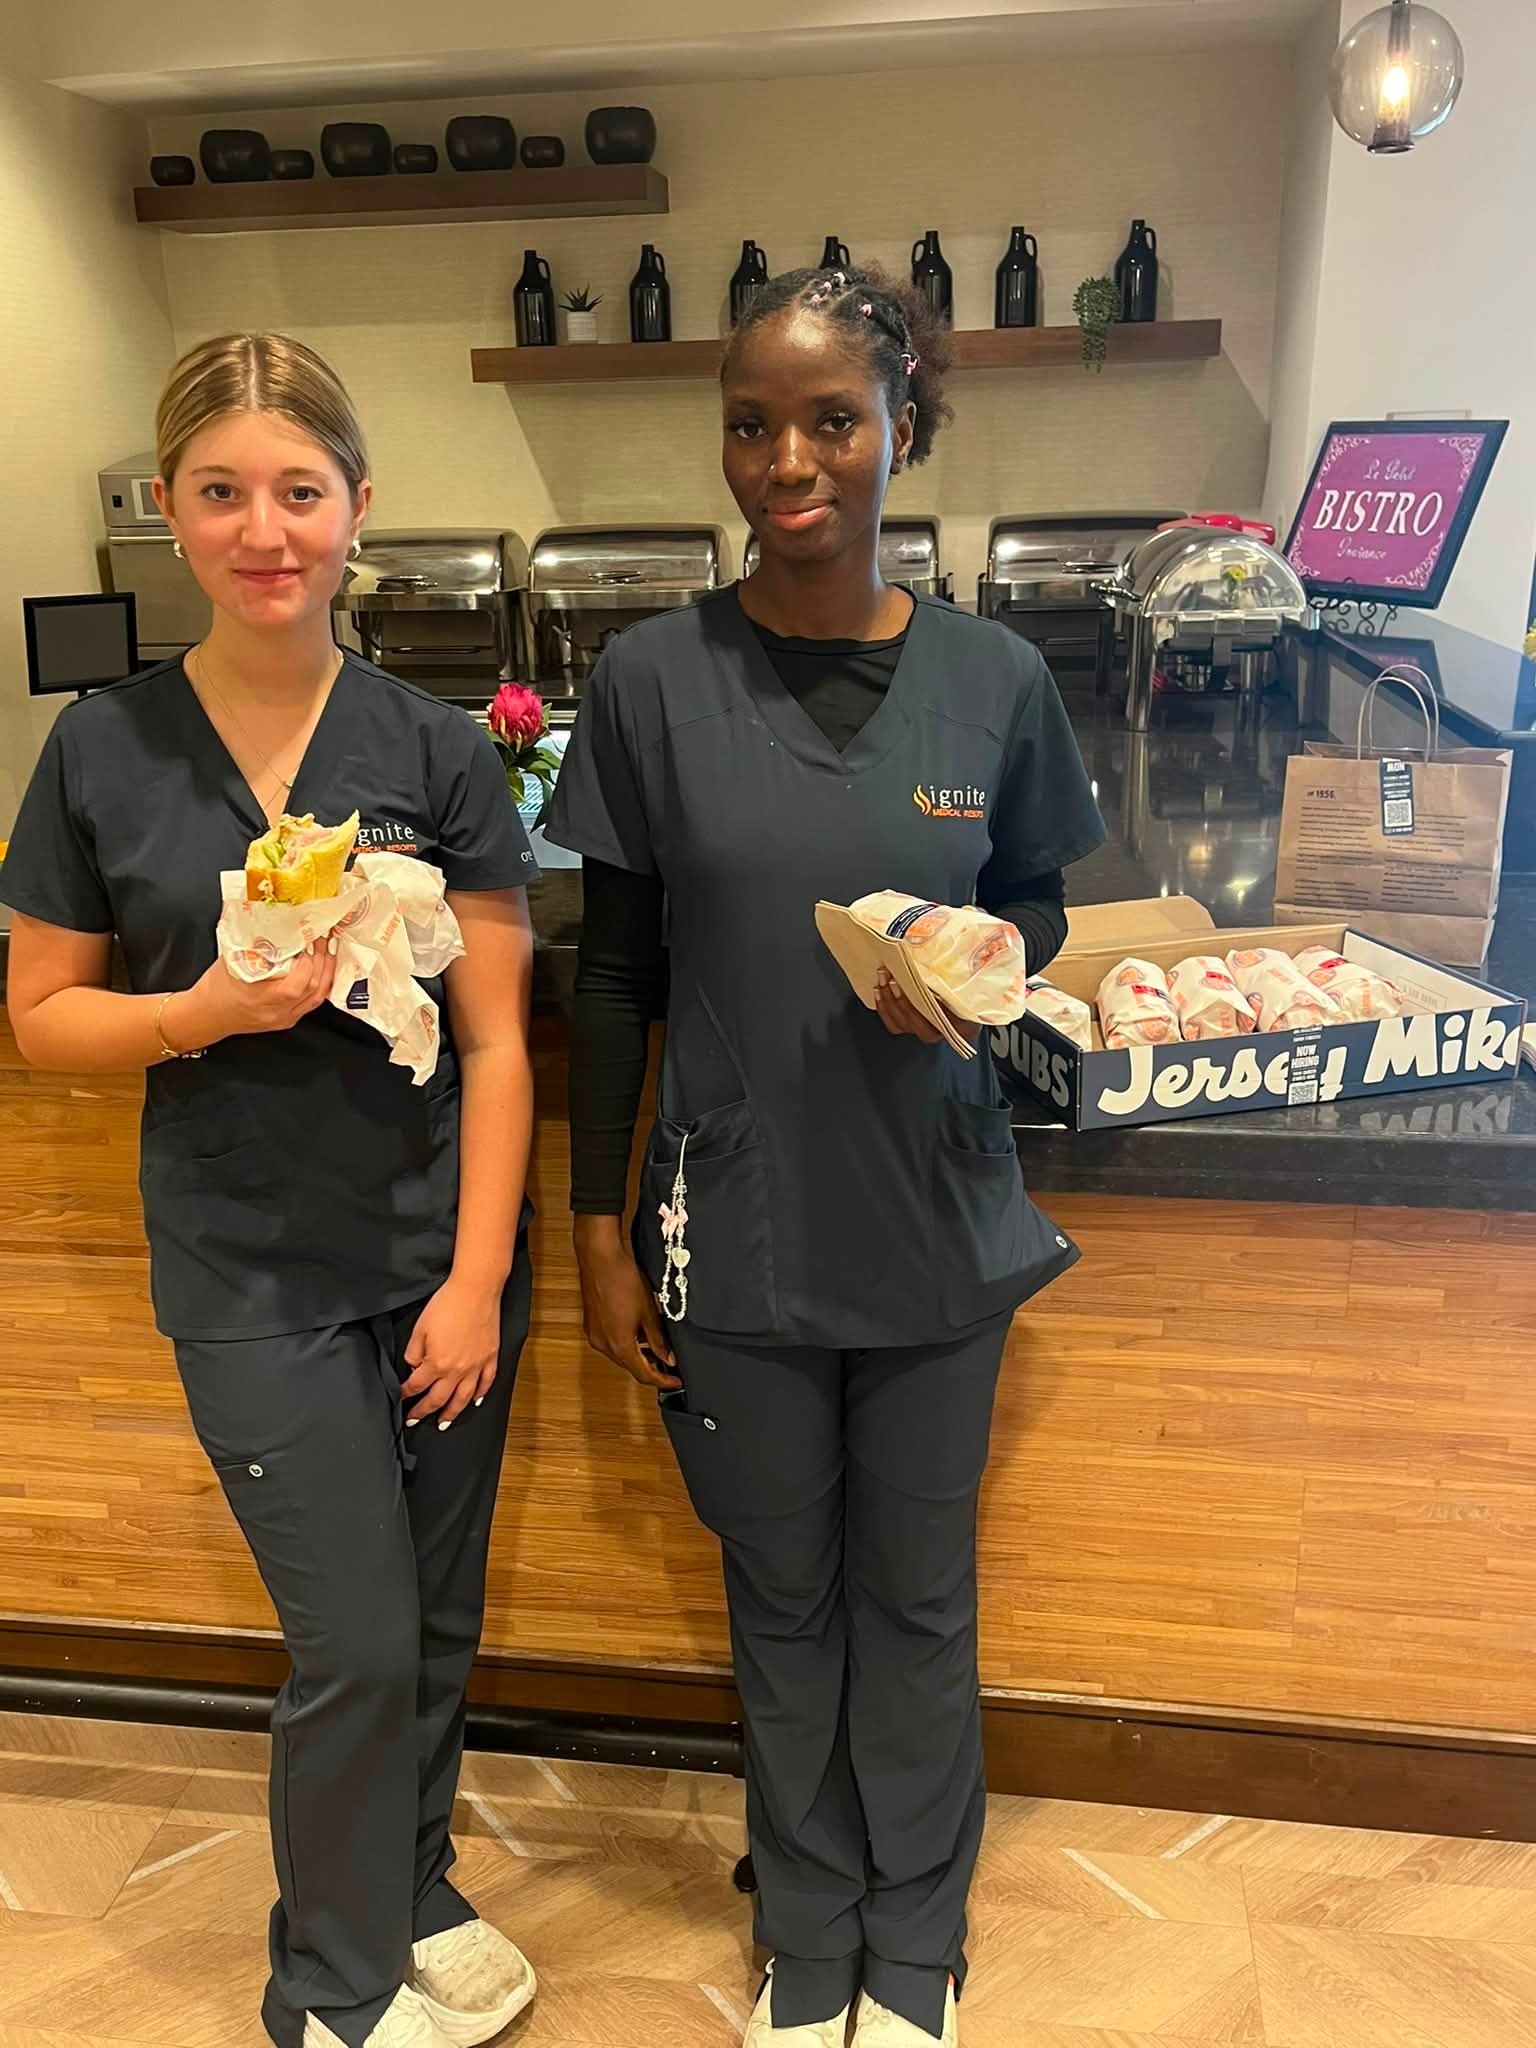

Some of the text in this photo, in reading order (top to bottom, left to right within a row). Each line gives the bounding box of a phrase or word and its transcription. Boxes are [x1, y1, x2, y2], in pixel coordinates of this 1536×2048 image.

[1313, 489, 1443, 536] BISTRO
[929, 785, 986, 809] ignite
[357, 822, 415, 847] gnite
